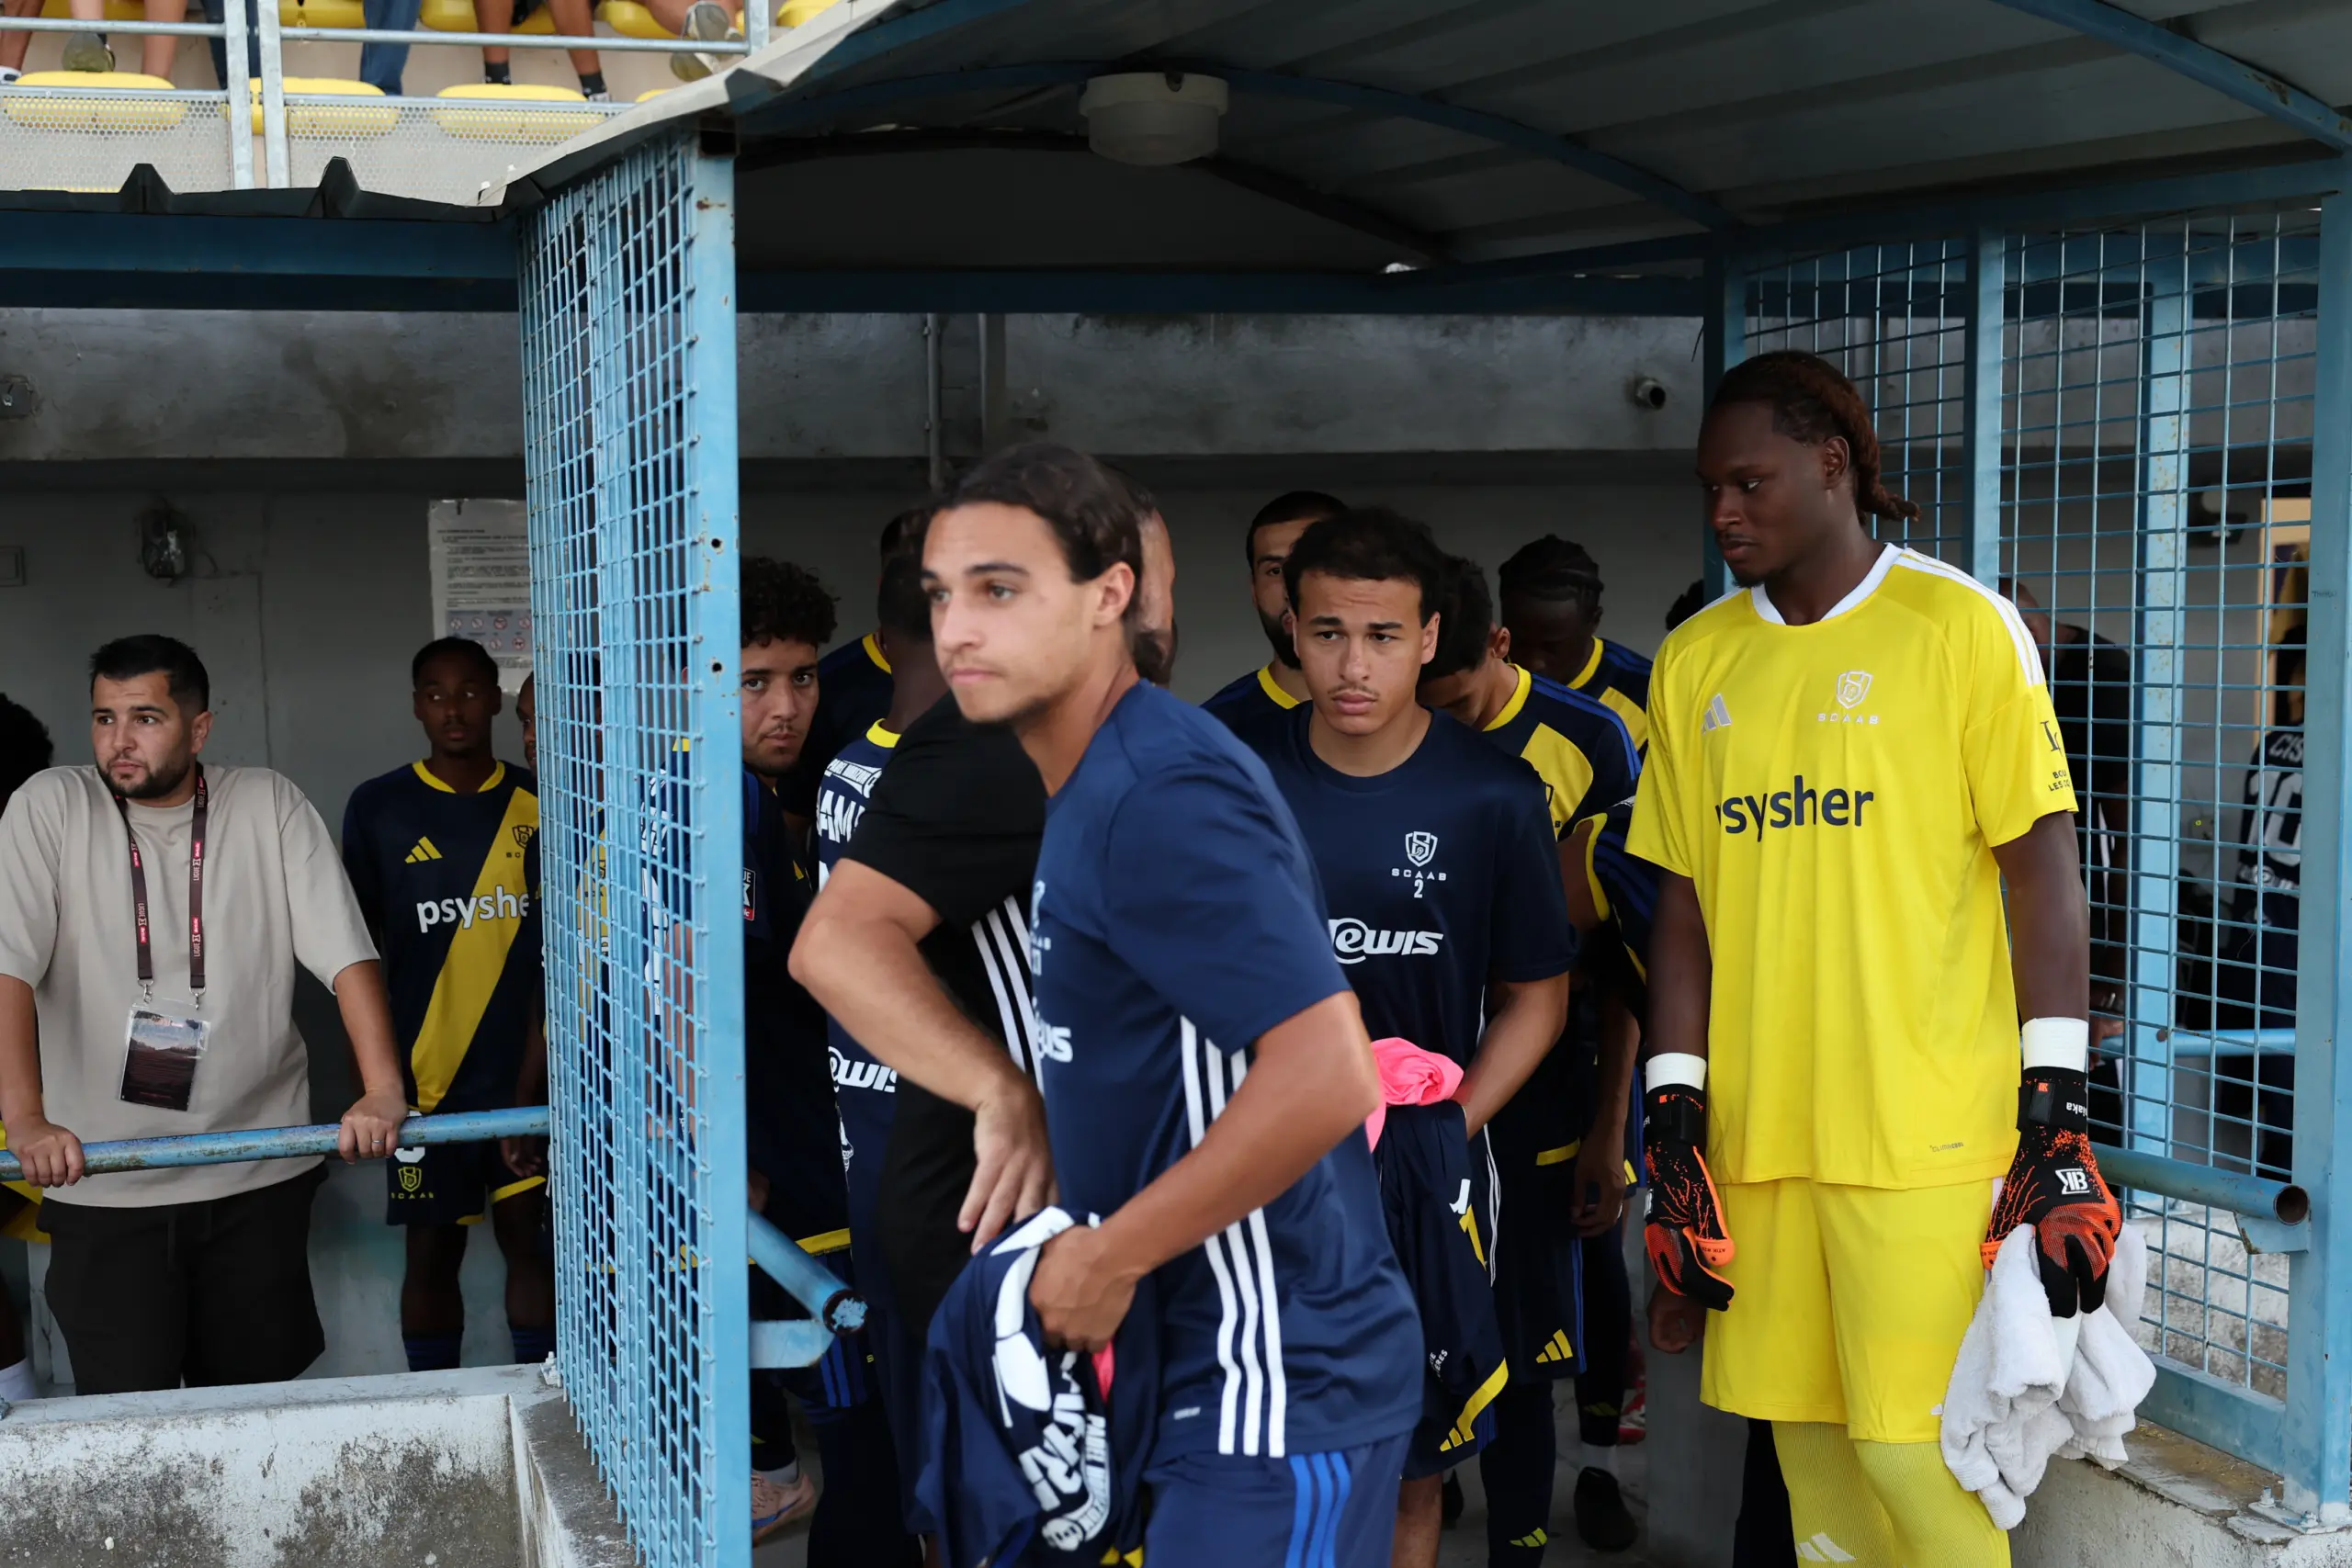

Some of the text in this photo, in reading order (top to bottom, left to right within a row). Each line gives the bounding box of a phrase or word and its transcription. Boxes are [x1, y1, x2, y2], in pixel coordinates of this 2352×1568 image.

[1715, 775, 1874, 842] sysher
[1391, 868, 1447, 881] SCAAB
[1414, 879, 1424, 898] 2
[416, 885, 529, 933] psyshe
